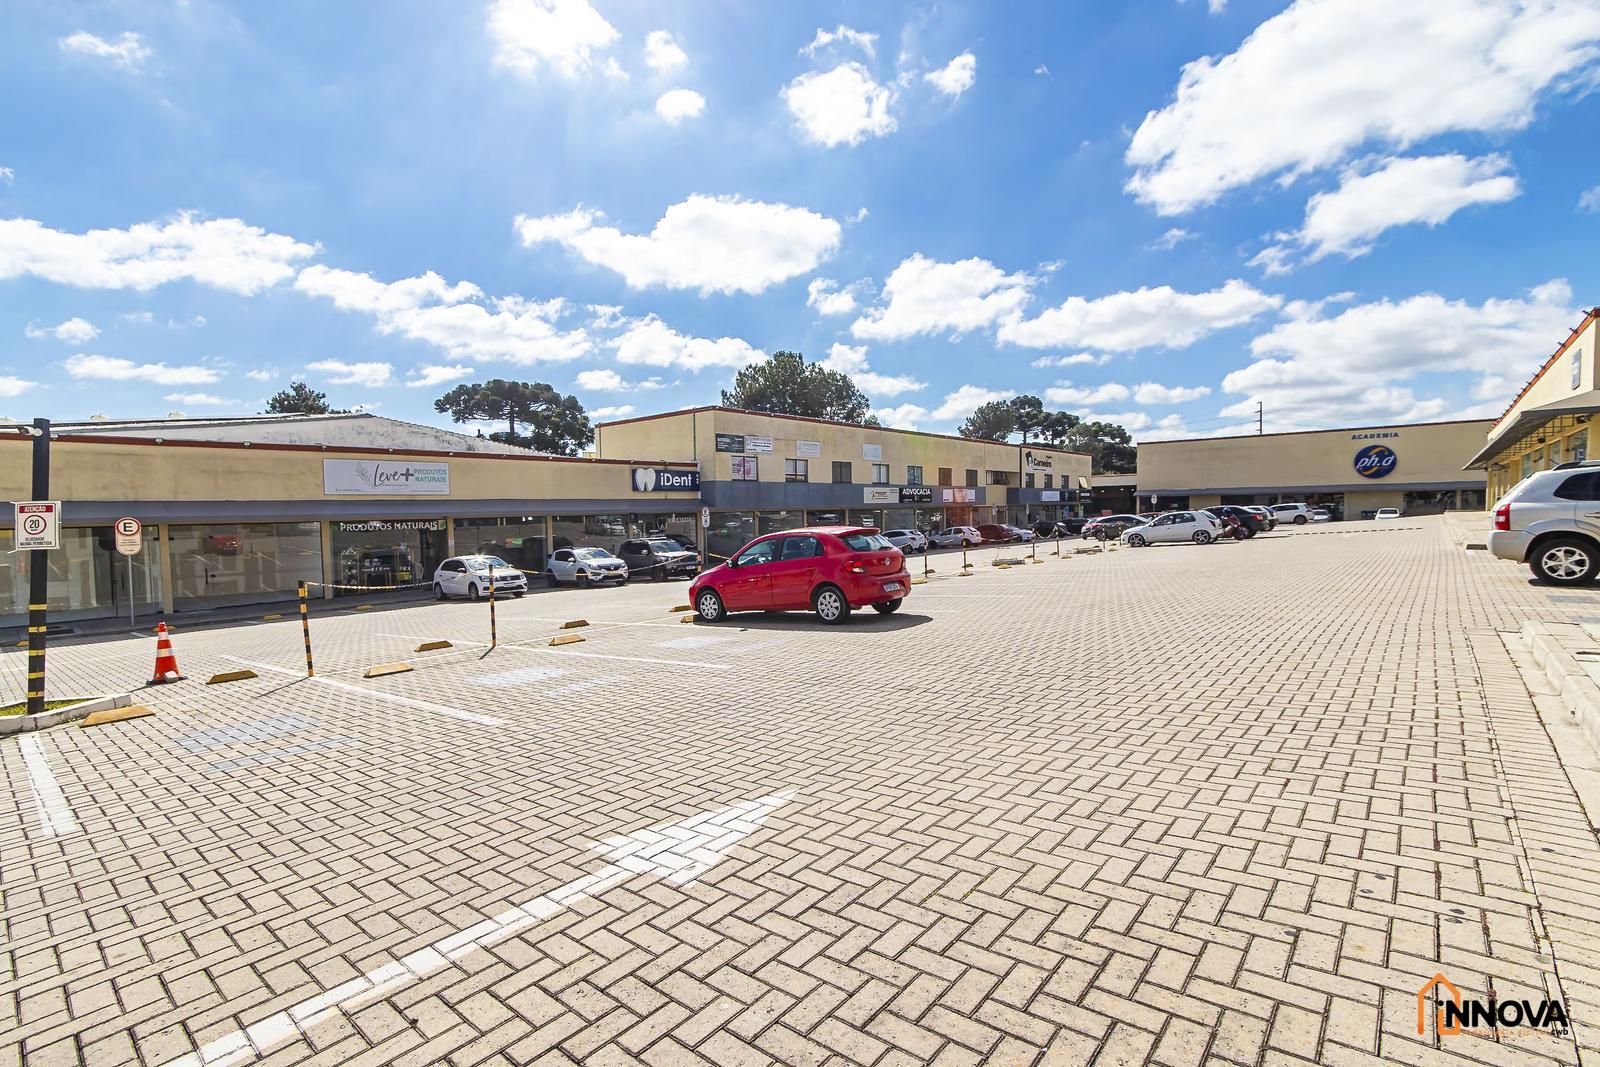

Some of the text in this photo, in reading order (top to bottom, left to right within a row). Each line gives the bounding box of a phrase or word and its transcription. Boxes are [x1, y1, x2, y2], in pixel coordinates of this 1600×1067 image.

[1351, 432, 1399, 440] ACADEMIA
[1356, 455, 1395, 469] ph.d
[660, 472, 692, 486] iDent
[29, 519, 40, 529] 20
[123, 522, 134, 532] E
[340, 521, 437, 532] PRODUTOS NATURAIS
